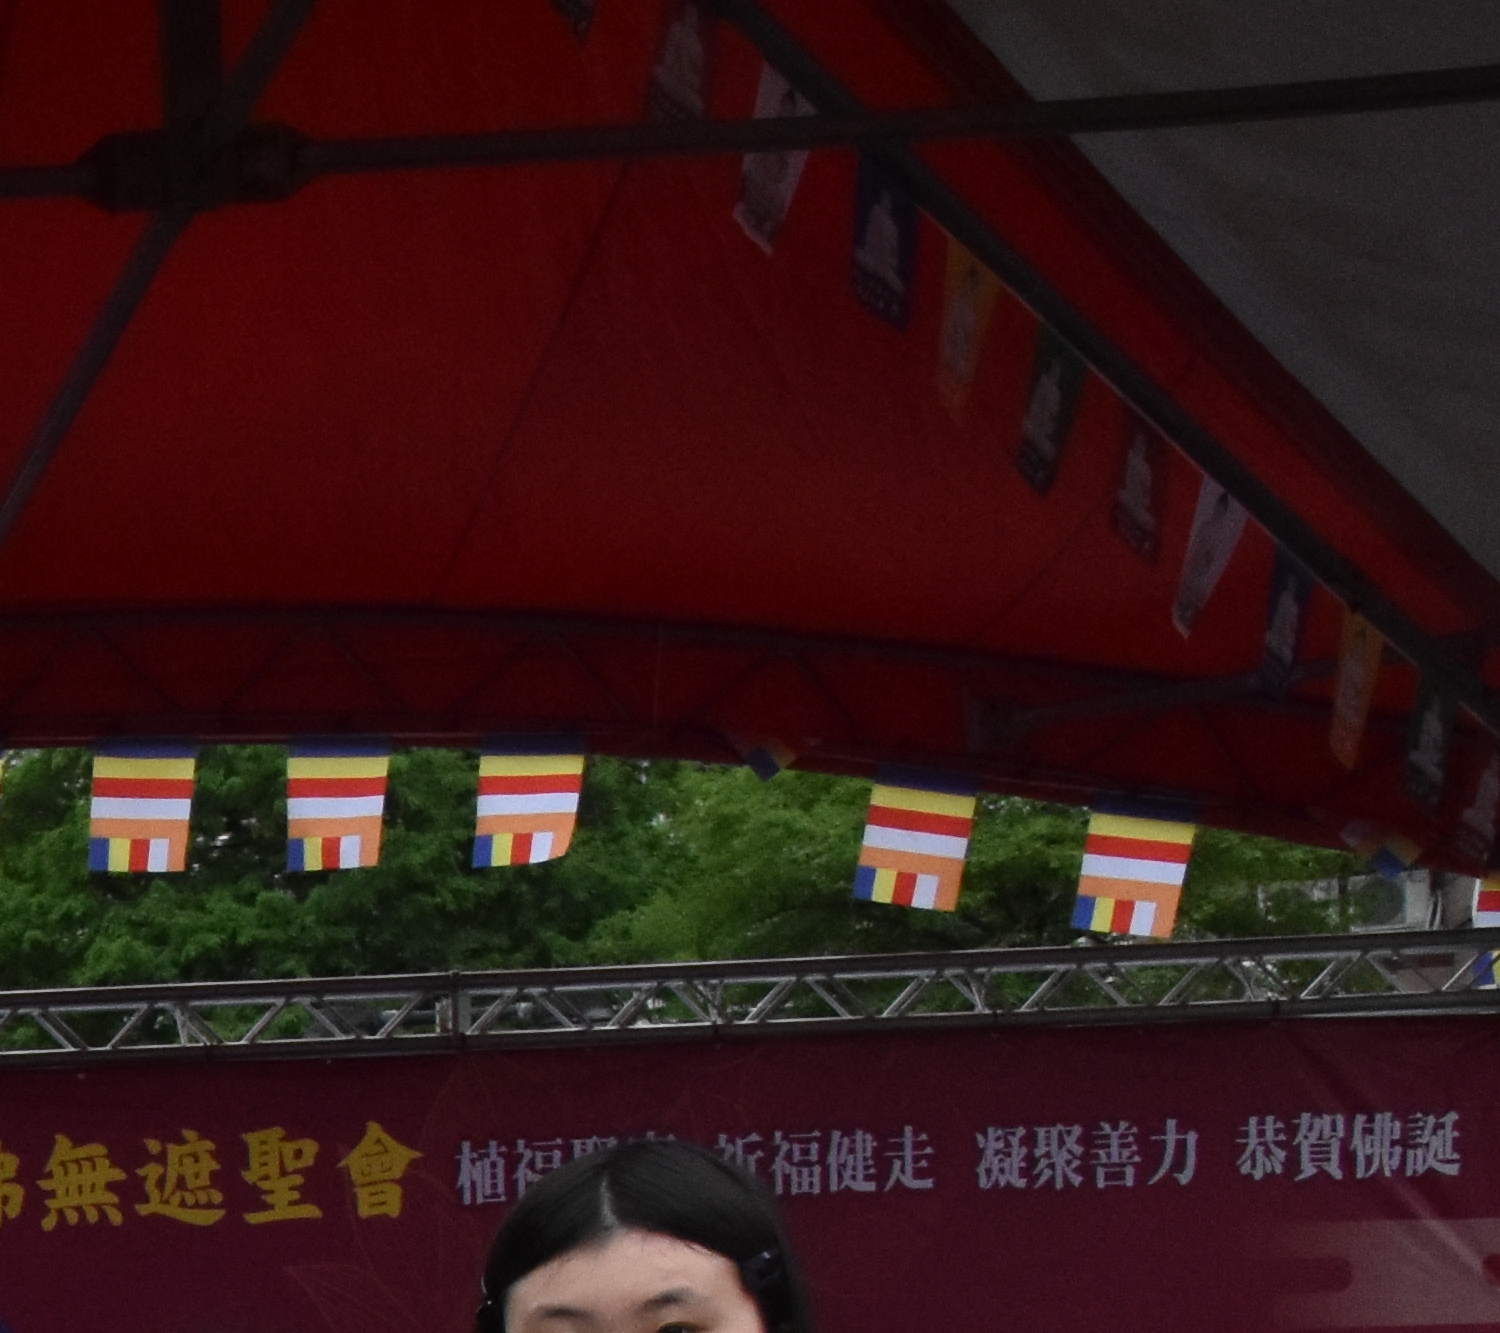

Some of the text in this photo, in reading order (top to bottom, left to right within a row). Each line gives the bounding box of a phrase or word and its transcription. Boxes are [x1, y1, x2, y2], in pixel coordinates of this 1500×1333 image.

[975, 1117, 1200, 1190] 凝聚善力
[1235, 1110, 1462, 1182] 恭賀佛誕
